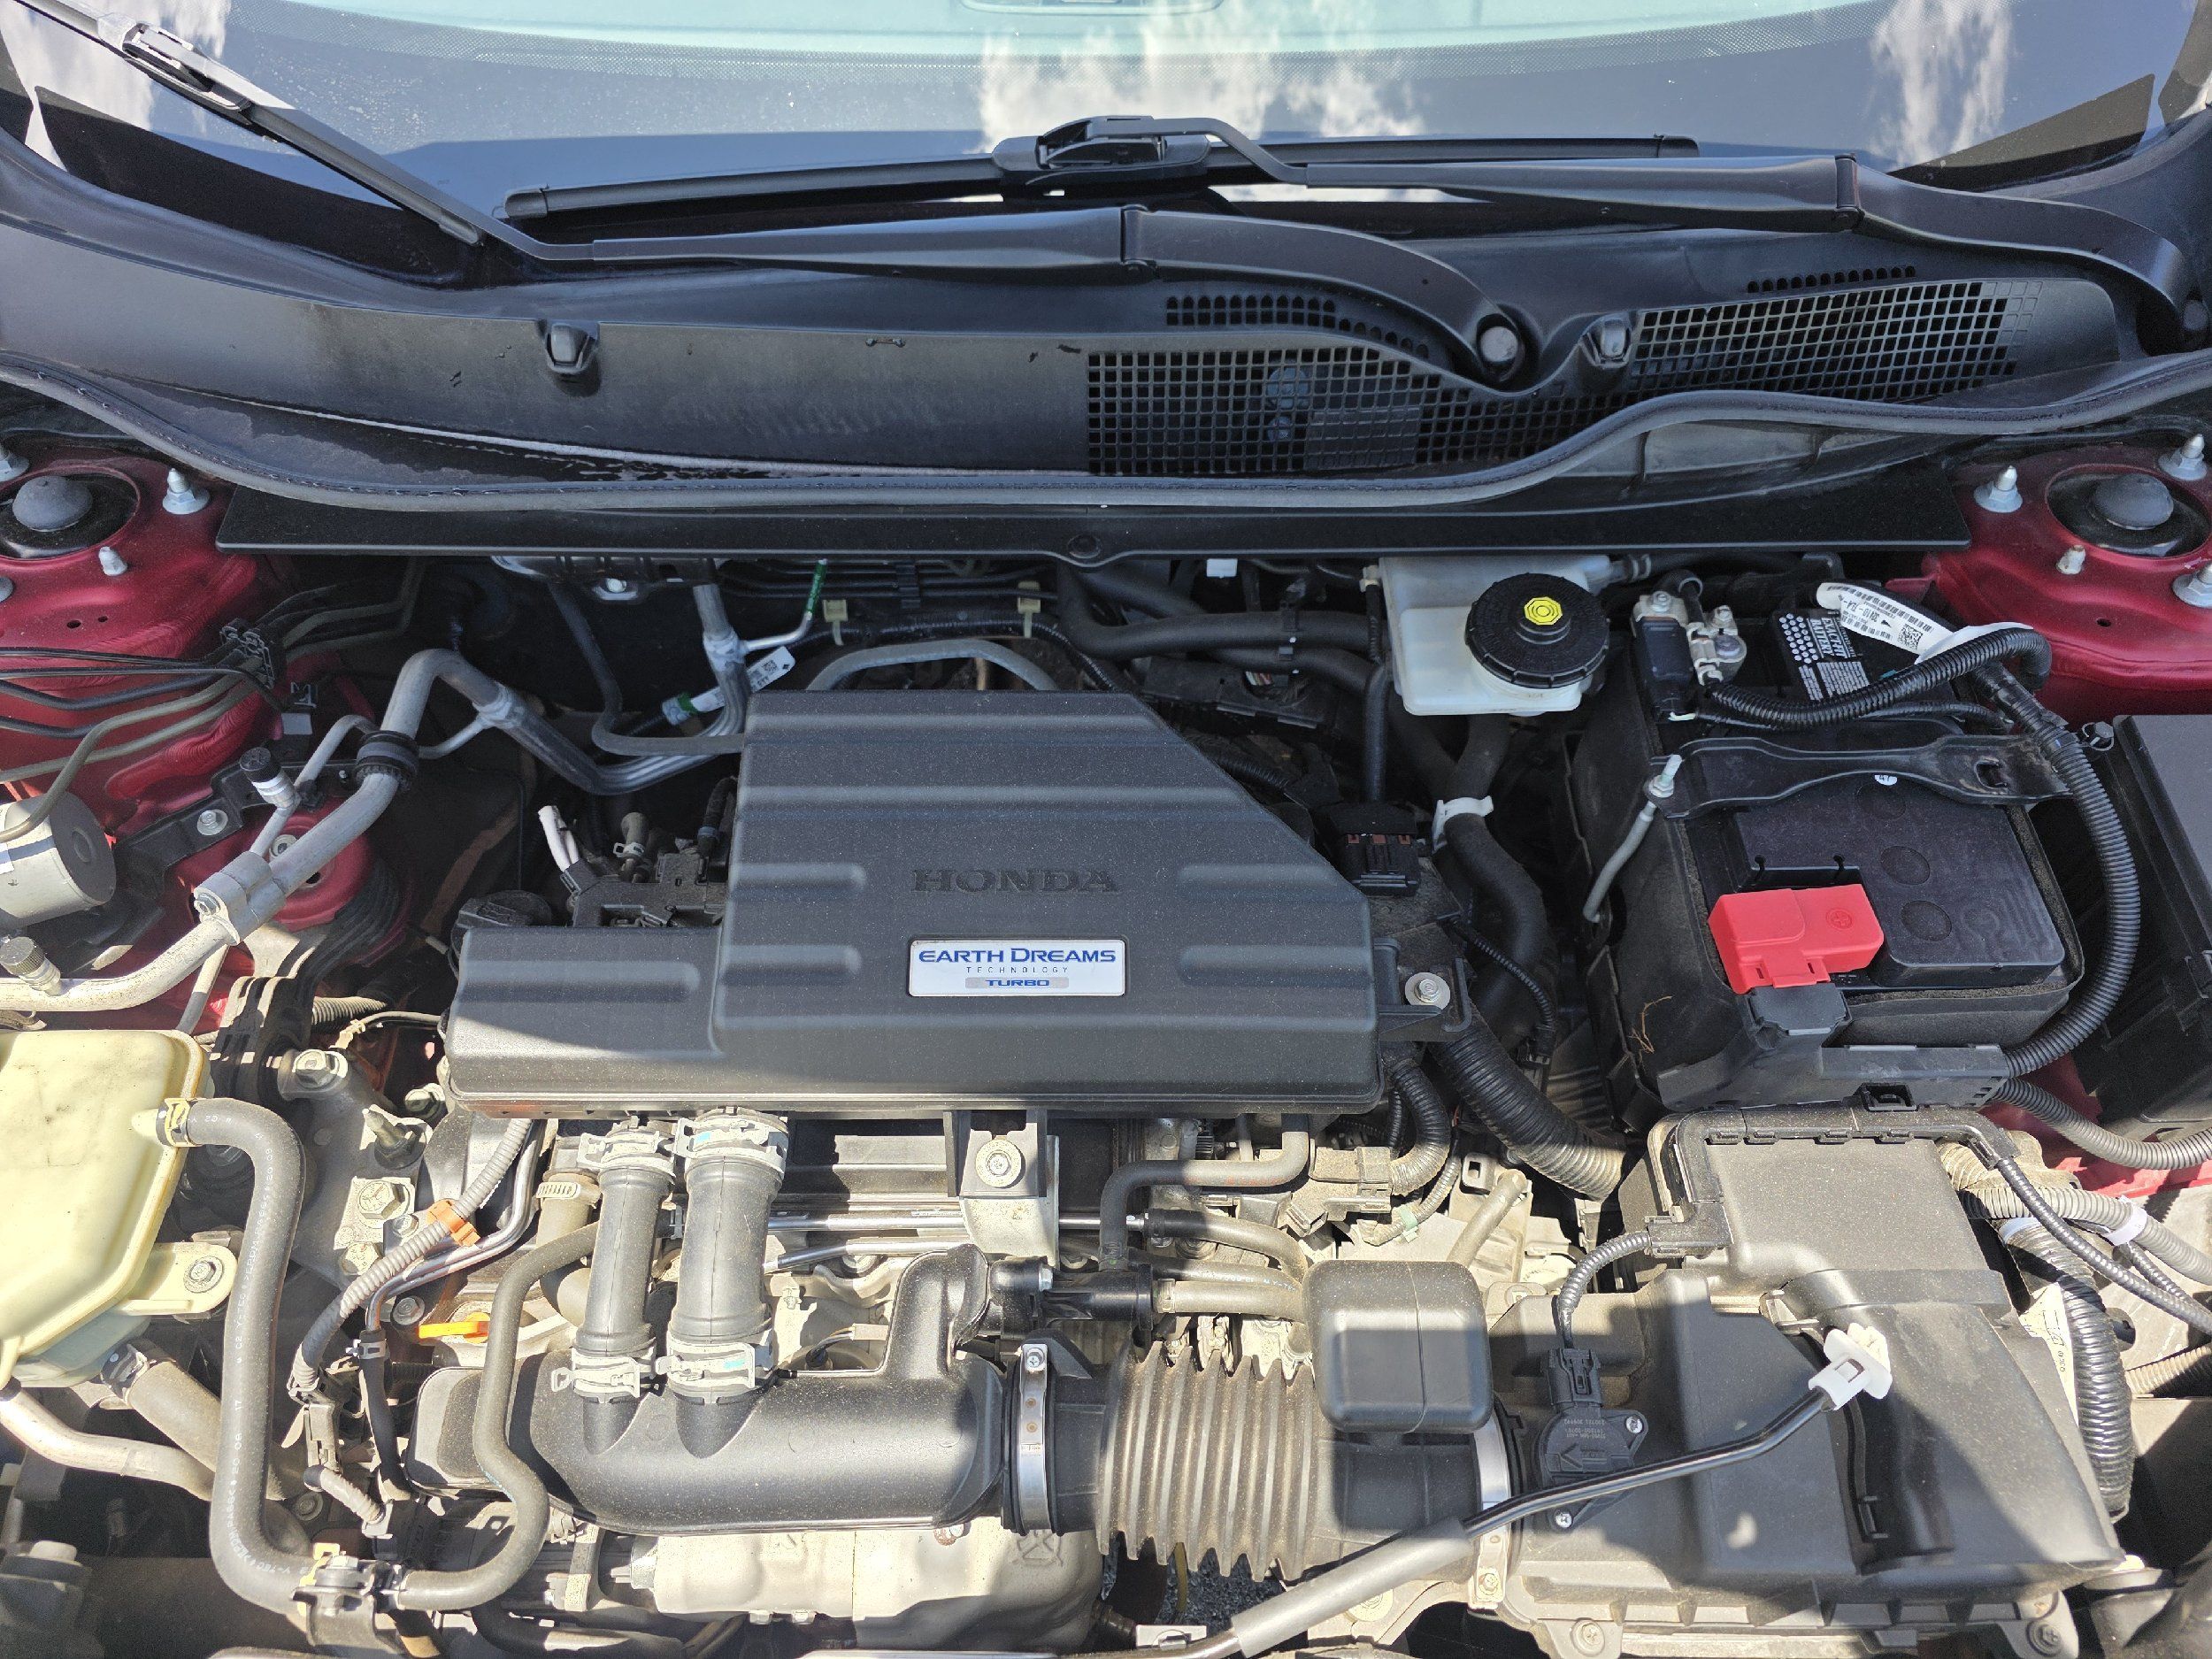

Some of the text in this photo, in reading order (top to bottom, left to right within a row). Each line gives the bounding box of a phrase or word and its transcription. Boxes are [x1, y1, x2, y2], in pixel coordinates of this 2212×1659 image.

[1809, 617, 1835, 657] BATTERY
[910, 869, 1120, 893] HONDA
[918, 948, 1117, 963] EARTH DREAMS
